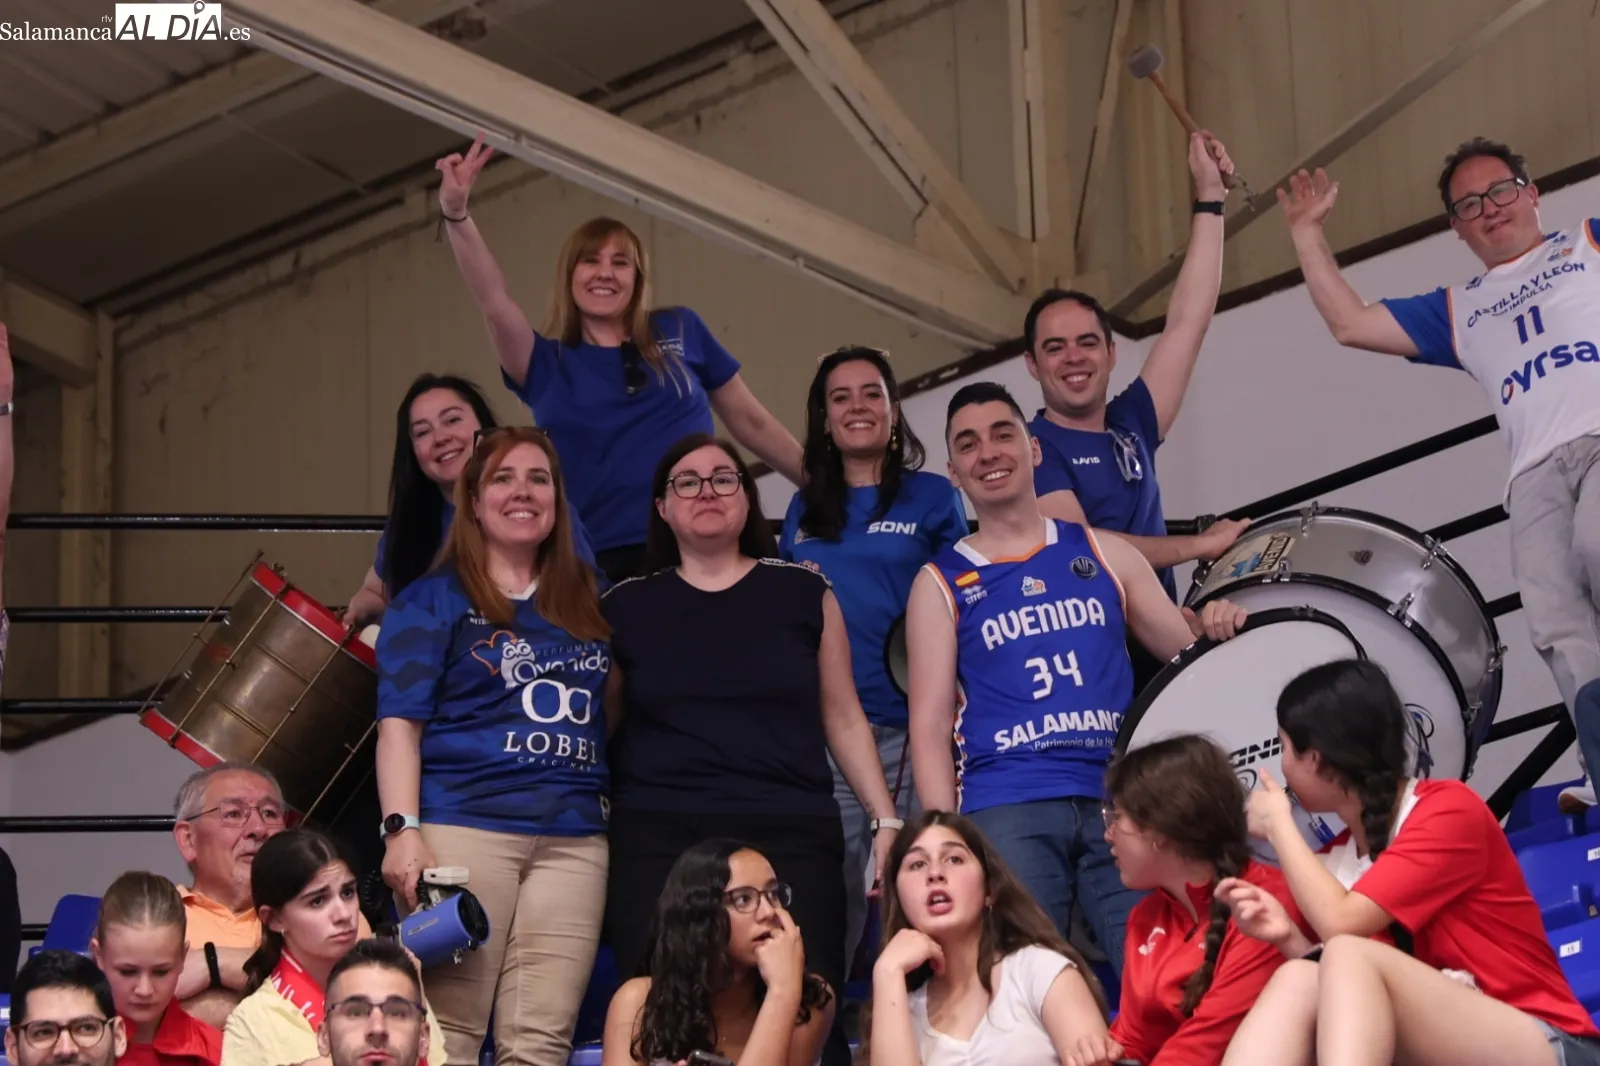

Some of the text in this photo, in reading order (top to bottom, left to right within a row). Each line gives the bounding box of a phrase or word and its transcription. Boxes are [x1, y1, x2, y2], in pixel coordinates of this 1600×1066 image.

[1467, 261, 1585, 328] CASTILLA Y LEÓN
[1509, 282, 1553, 312] IMPULSA
[1513, 305, 1545, 345] 11
[867, 521, 917, 535] SONI
[981, 597, 1106, 651] AVENIDA
[1024, 649, 1084, 700] 34
[994, 709, 1124, 754] SALAMANC
[1034, 737, 1083, 751] Patrimonio
[1085, 738, 1095, 747] de
